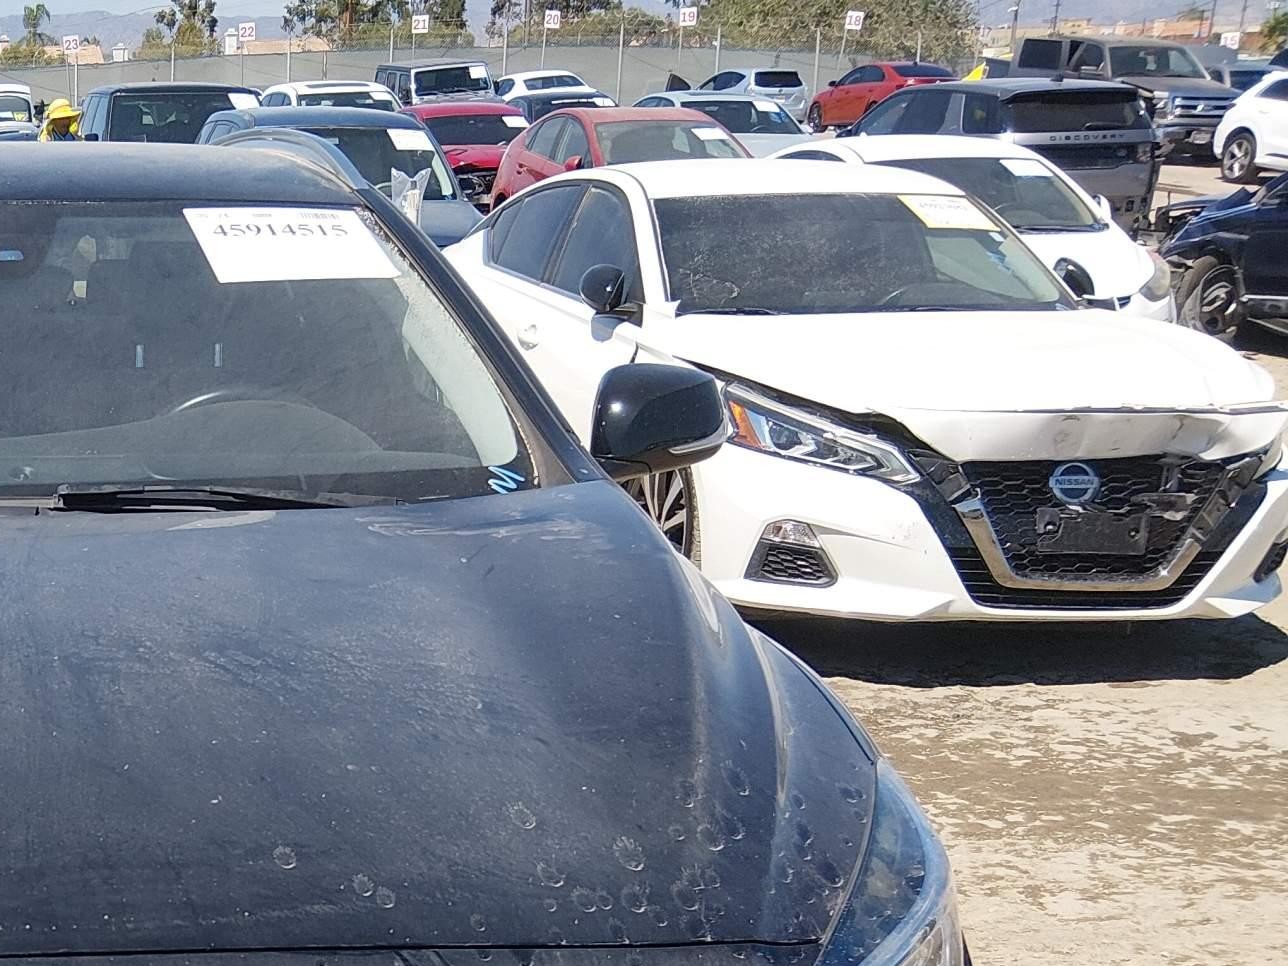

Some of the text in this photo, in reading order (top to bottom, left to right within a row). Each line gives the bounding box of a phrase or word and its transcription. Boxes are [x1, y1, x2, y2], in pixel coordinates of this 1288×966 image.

[546, 14, 559, 25] 20
[680, 12, 695, 23] 19
[847, 15, 862, 26] 18
[413, 19, 428, 30] 21
[240, 26, 255, 38] 22
[64, 38, 79, 50] 23
[212, 223, 349, 237] 45914515
[1054, 478, 1095, 487] NISSAN
